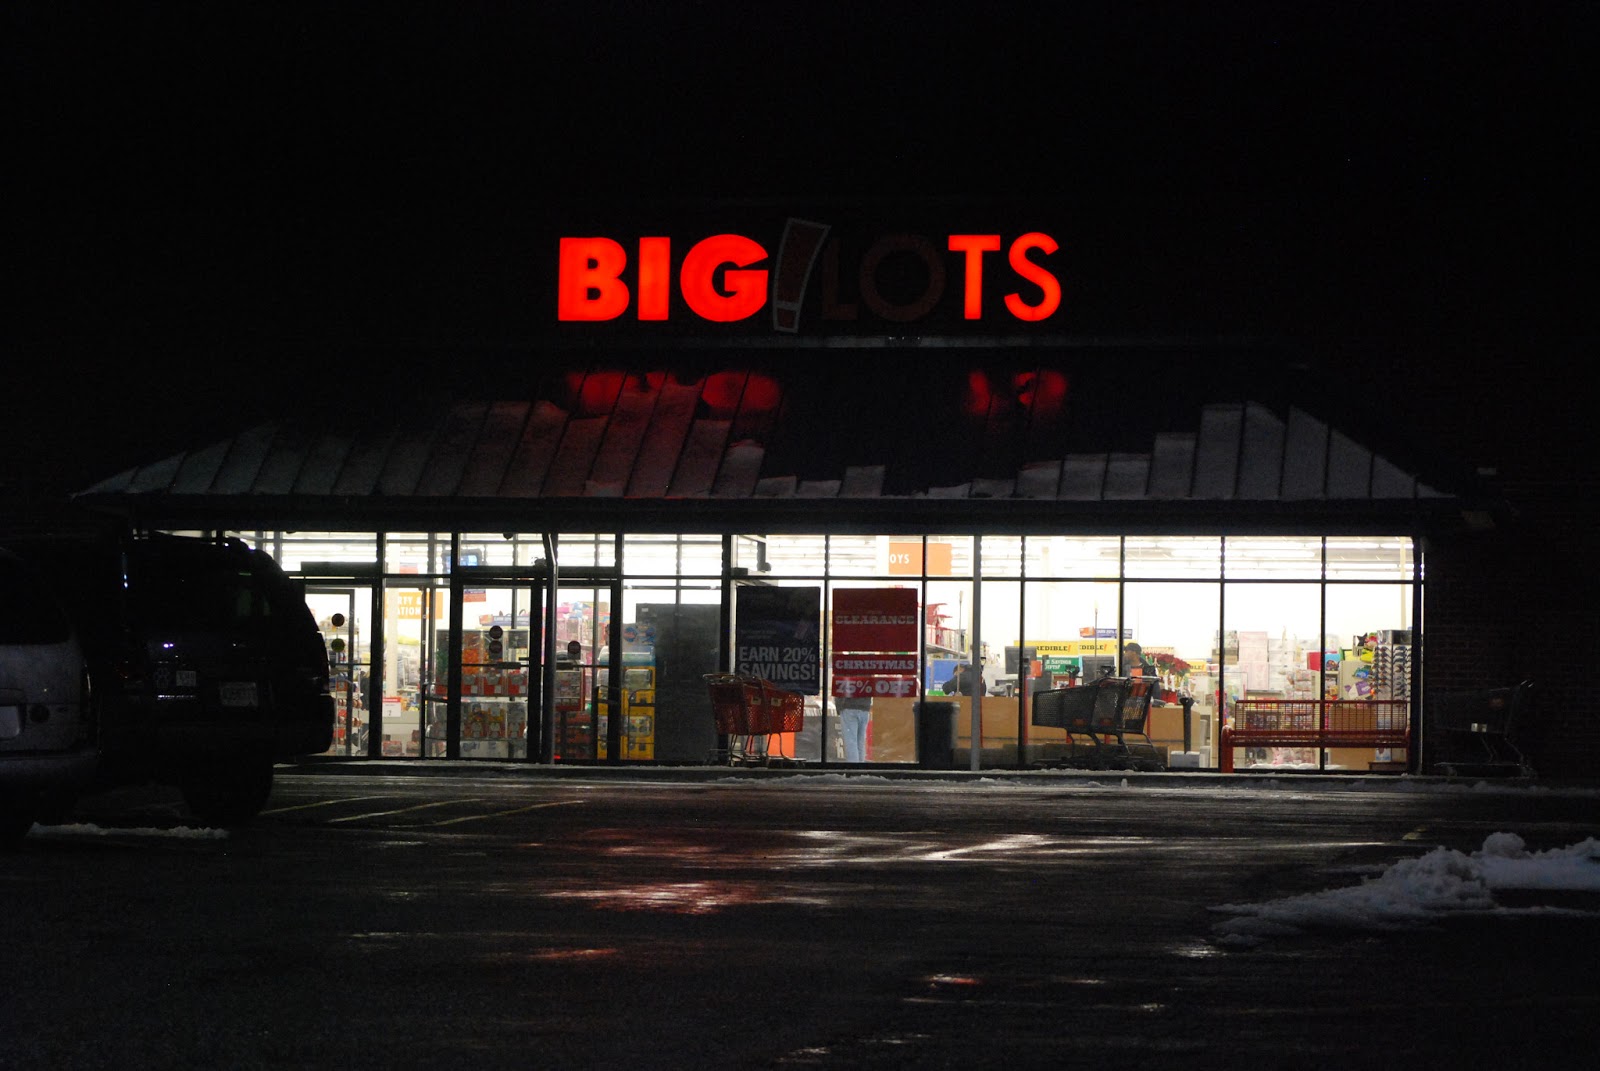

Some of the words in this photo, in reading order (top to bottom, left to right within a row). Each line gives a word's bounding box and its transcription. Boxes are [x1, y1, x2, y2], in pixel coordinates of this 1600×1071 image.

[821, 231, 1062, 322] LOTS
[890, 553, 909, 564] OYS
[835, 615, 915, 625] CLEARANCE
[739, 646, 779, 662] EARN
[783, 647, 816, 662] 20%
[739, 662, 816, 680] SAVINGS!
[835, 660, 915, 669] CHRISTMAS
[835, 680, 872, 694] 75%
[875, 680, 914, 694] OFF
